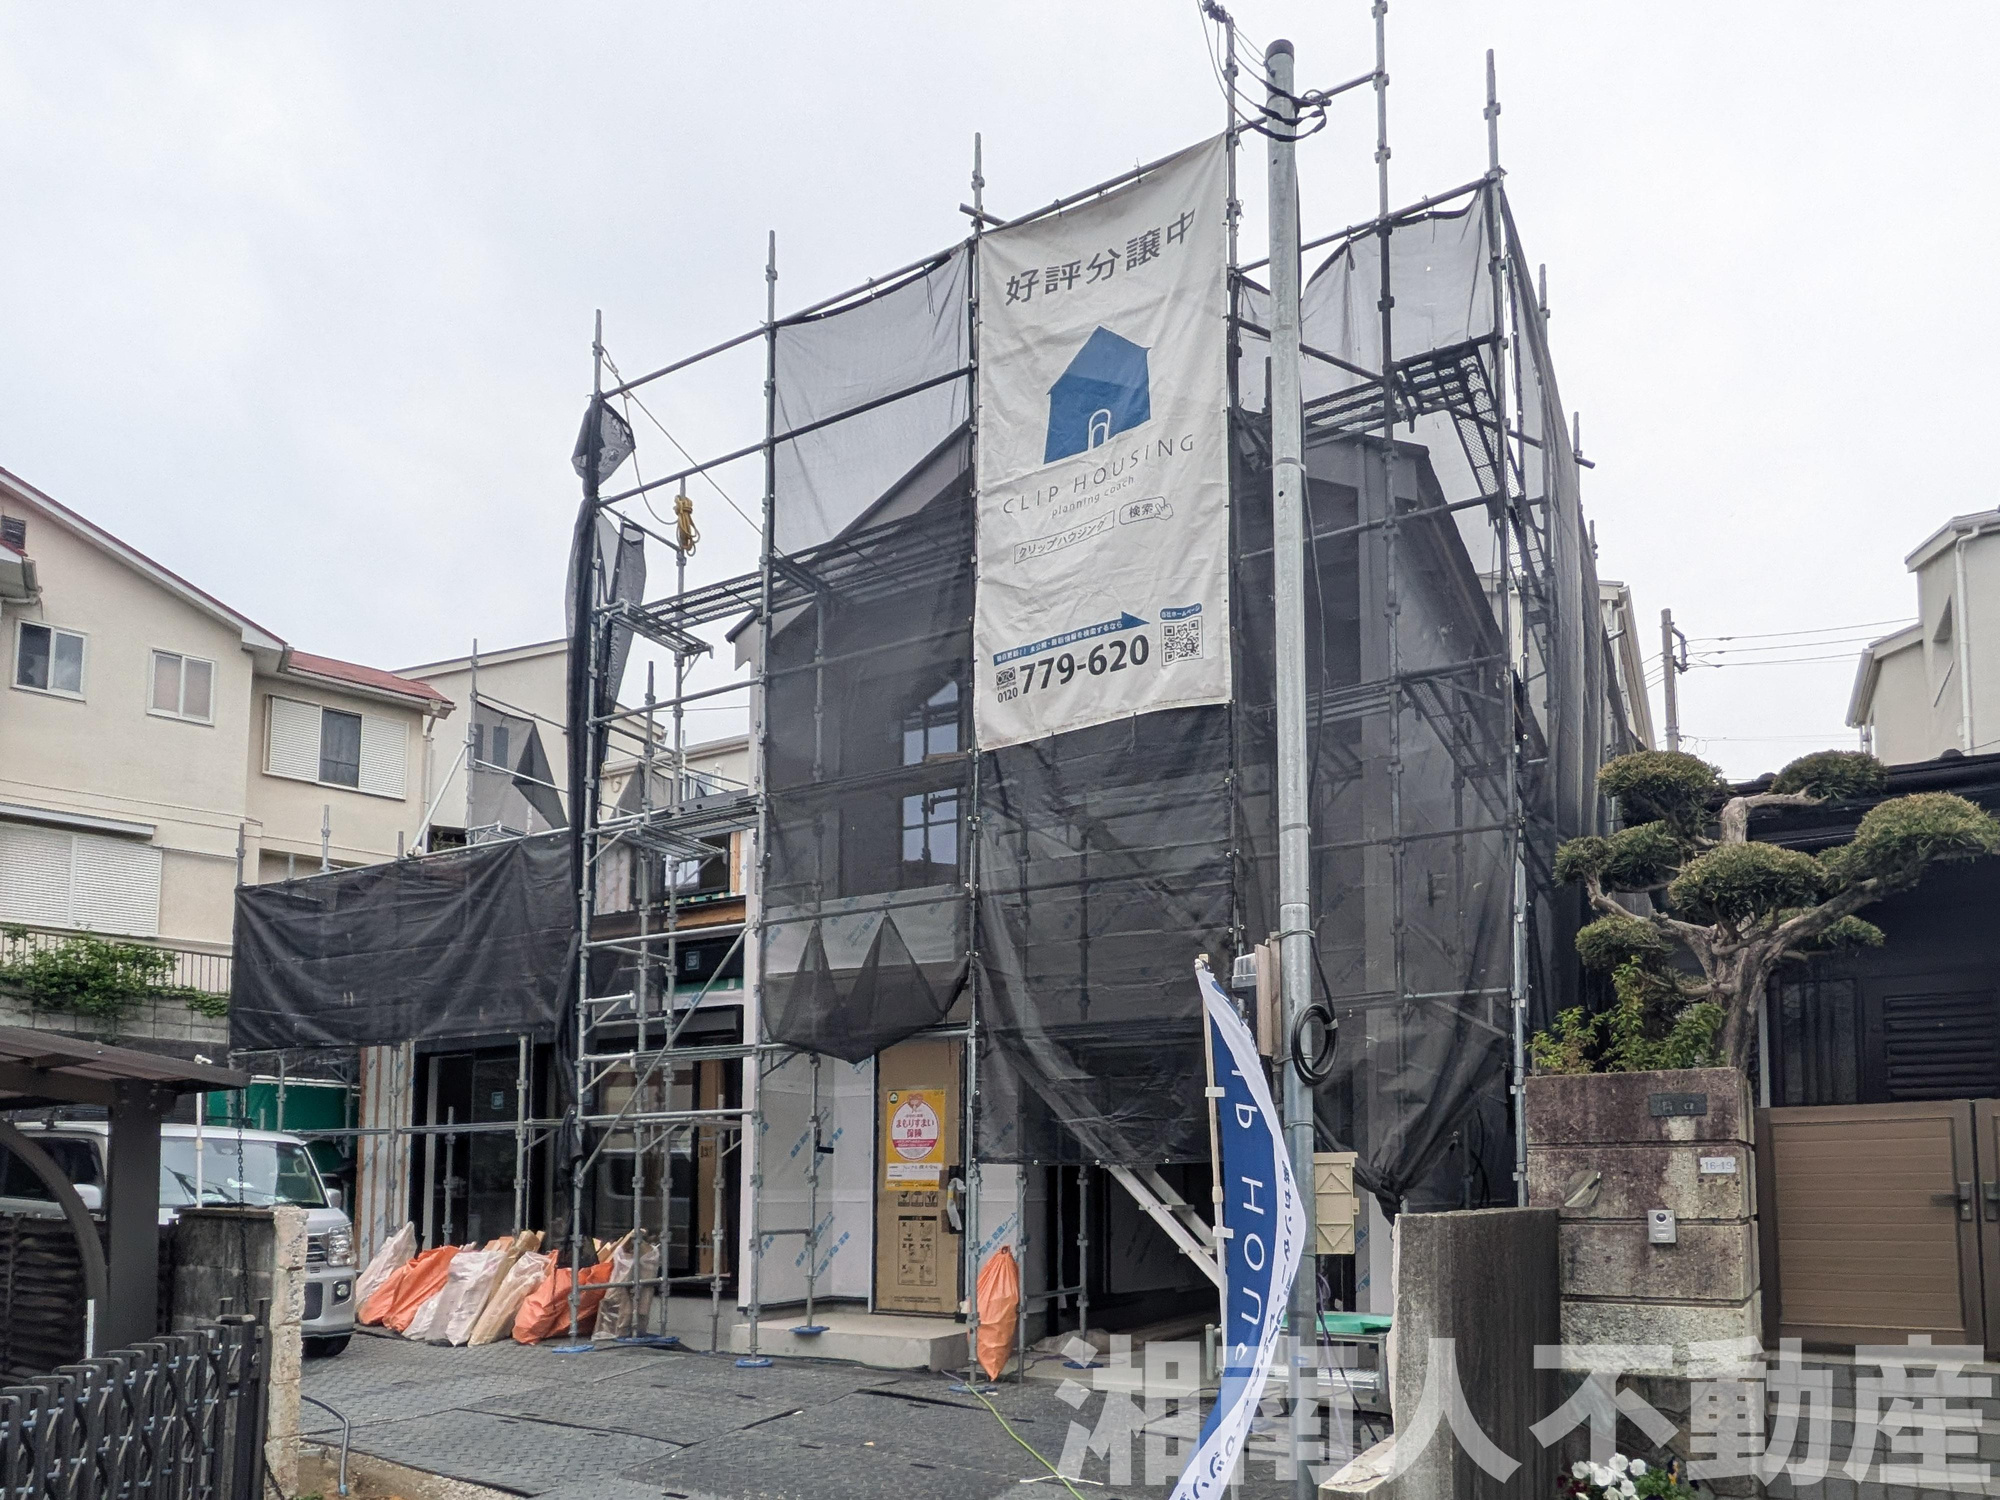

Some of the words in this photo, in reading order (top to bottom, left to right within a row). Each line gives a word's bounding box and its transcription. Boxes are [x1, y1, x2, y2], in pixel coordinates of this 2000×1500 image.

[1005, 209, 1196, 306] 好評分譲中
[1003, 485, 1058, 514] CLIP
[1073, 434, 1194, 494] HOUSING
[1051, 493, 1100, 519] planning
[1104, 475, 1134, 496] coach
[1129, 503, 1154, 518] 検索
[1019, 517, 1107, 558] クリップハウジング
[1019, 635, 1150, 694] 779-620
[997, 687, 1018, 703] 0120
[896, 1118, 934, 1128] まもりすまい
[906, 1128, 922, 1138] 保険
[1704, 1161, 1733, 1170] 16-19
